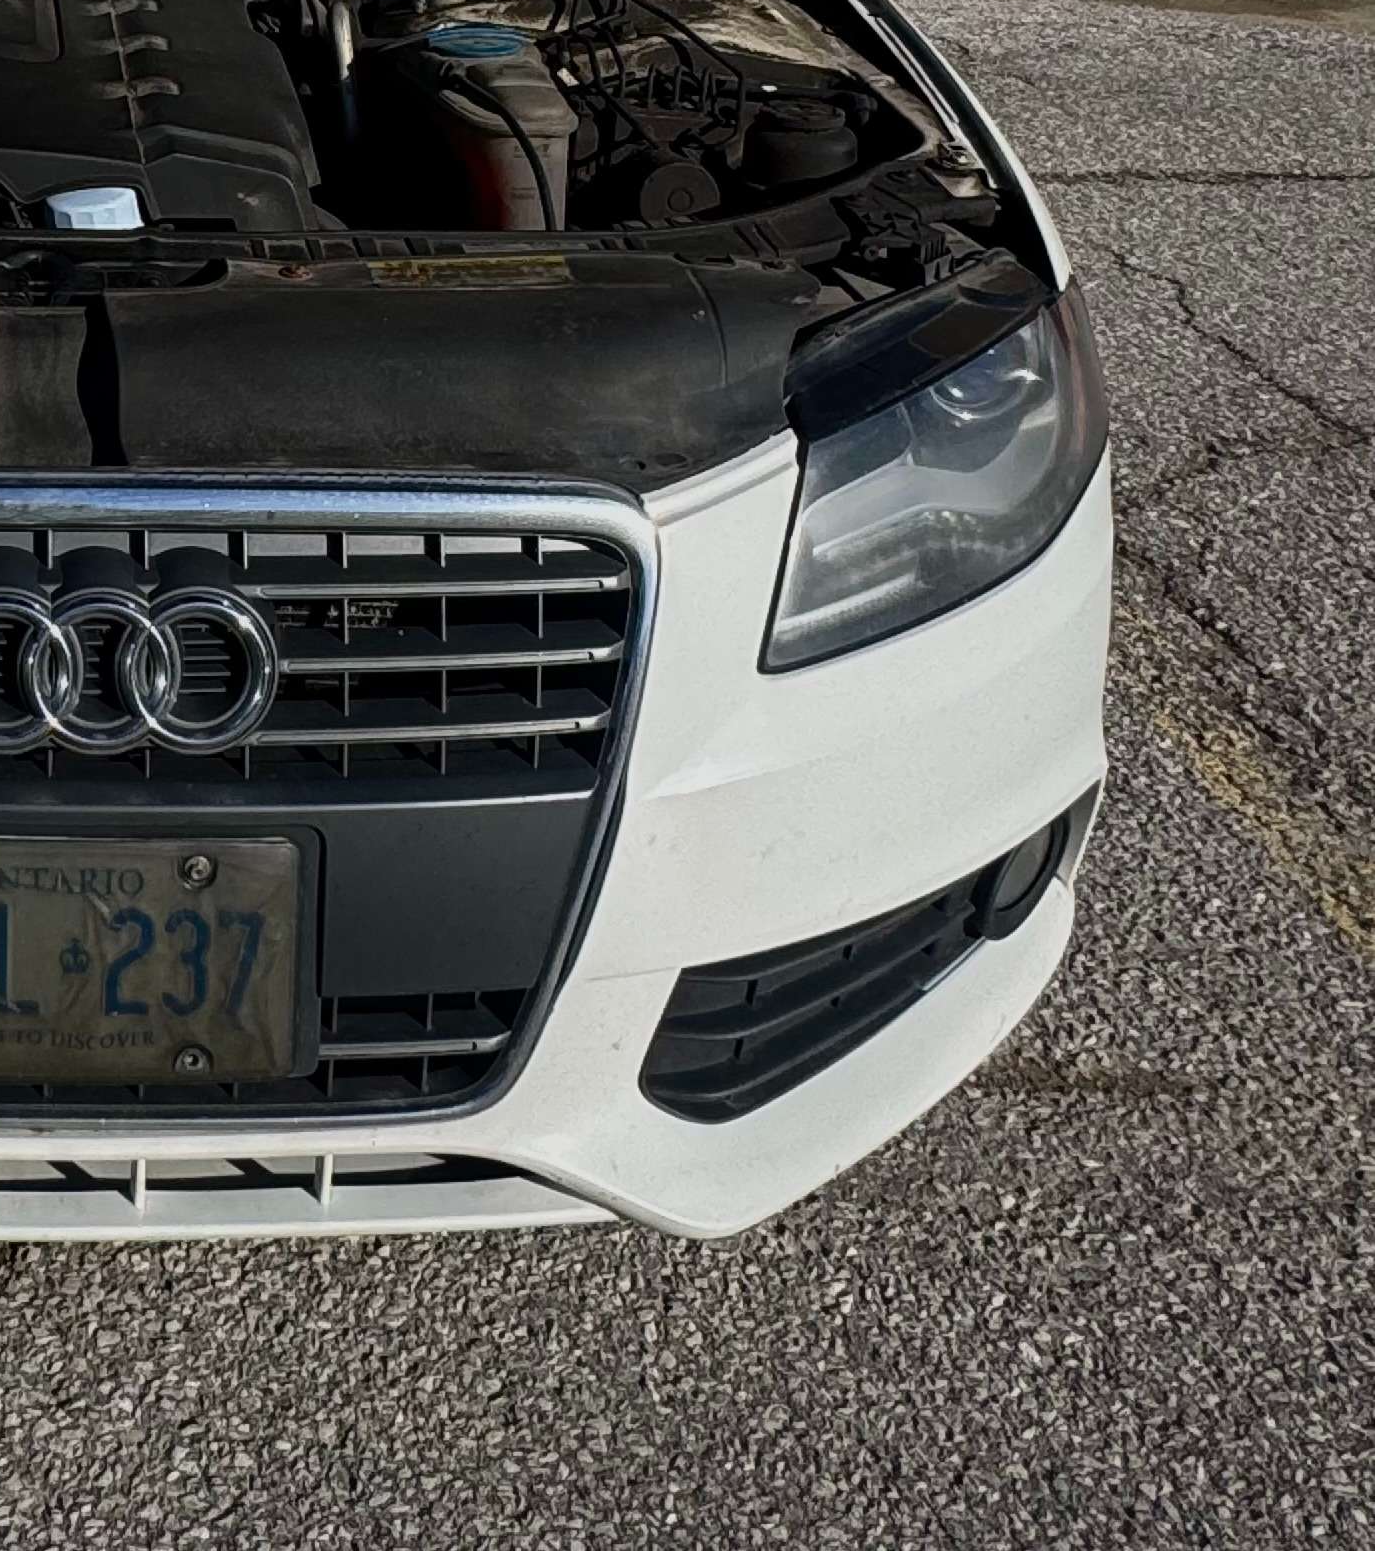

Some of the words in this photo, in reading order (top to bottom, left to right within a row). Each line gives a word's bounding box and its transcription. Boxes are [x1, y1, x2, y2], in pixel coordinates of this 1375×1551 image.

[104, 907, 266, 1016] 237
[16, 1029, 43, 1045] TO
[49, 1030, 155, 1049] DISCOVER
